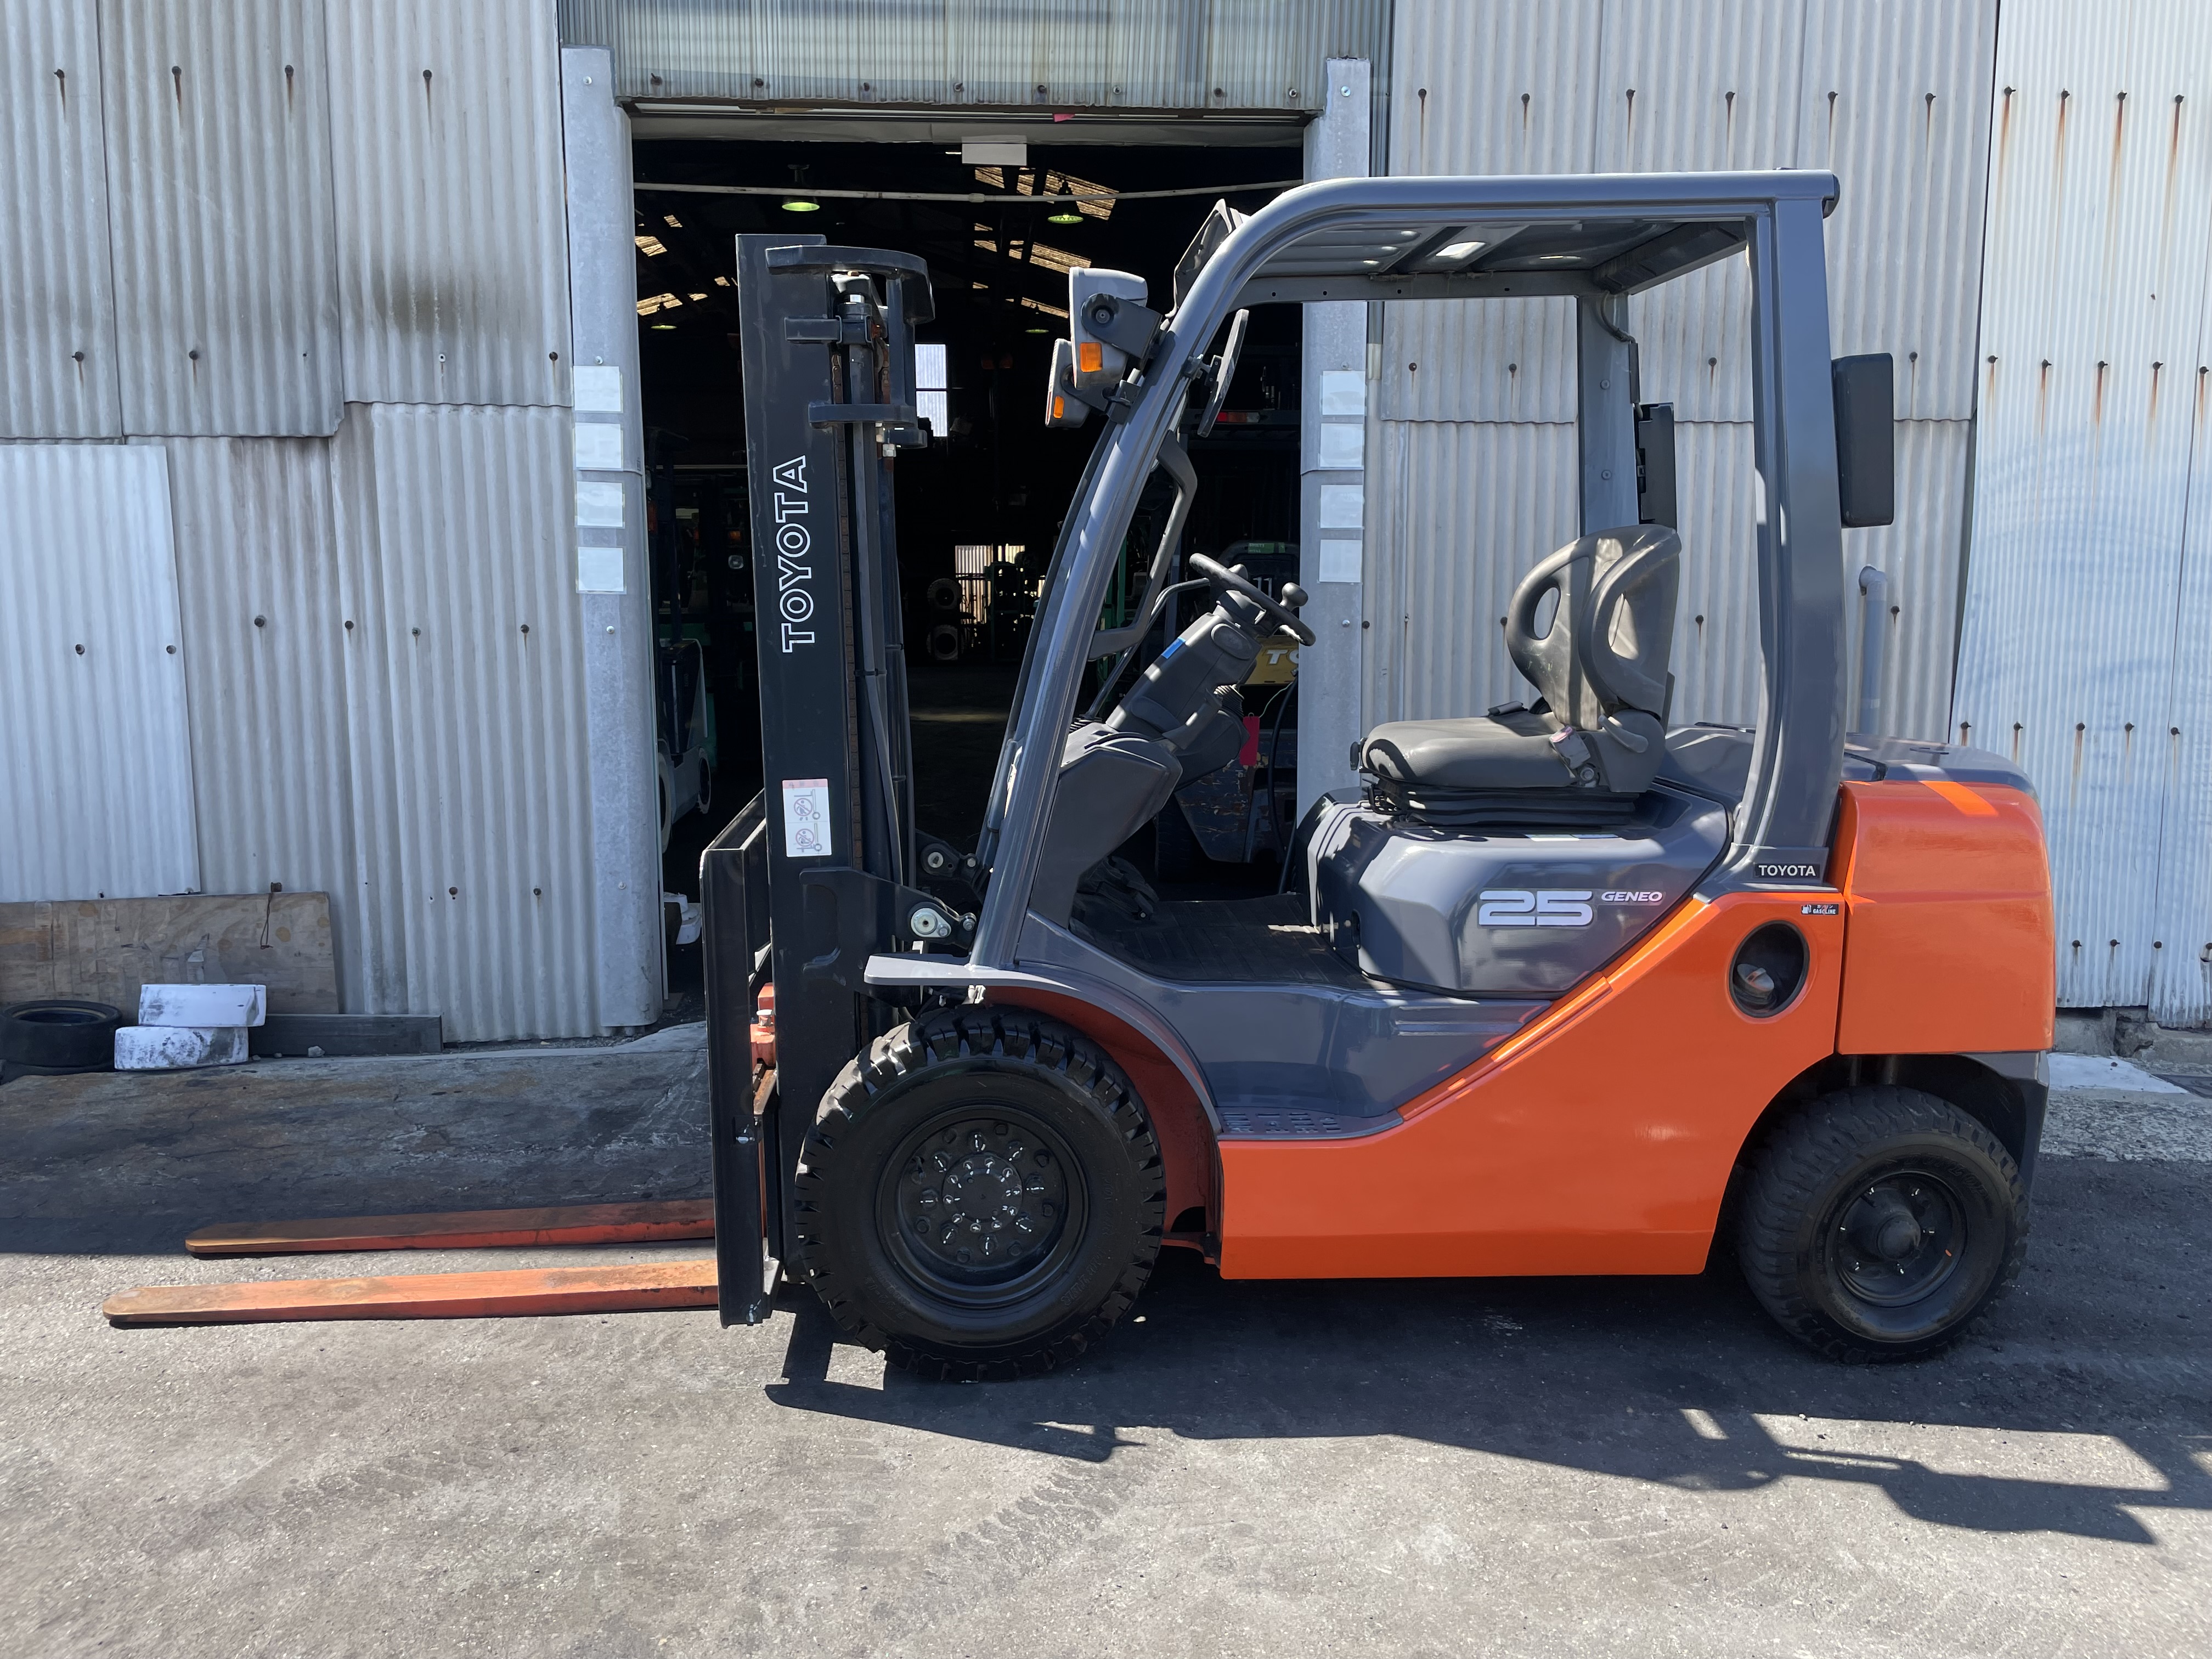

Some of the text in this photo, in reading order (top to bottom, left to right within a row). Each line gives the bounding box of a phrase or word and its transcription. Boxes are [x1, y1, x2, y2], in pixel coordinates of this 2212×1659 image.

[772, 455, 815, 653] TOYOTA
[1758, 865, 1816, 876] TOYOTA
[1479, 890, 1663, 926] 25 GENEO
